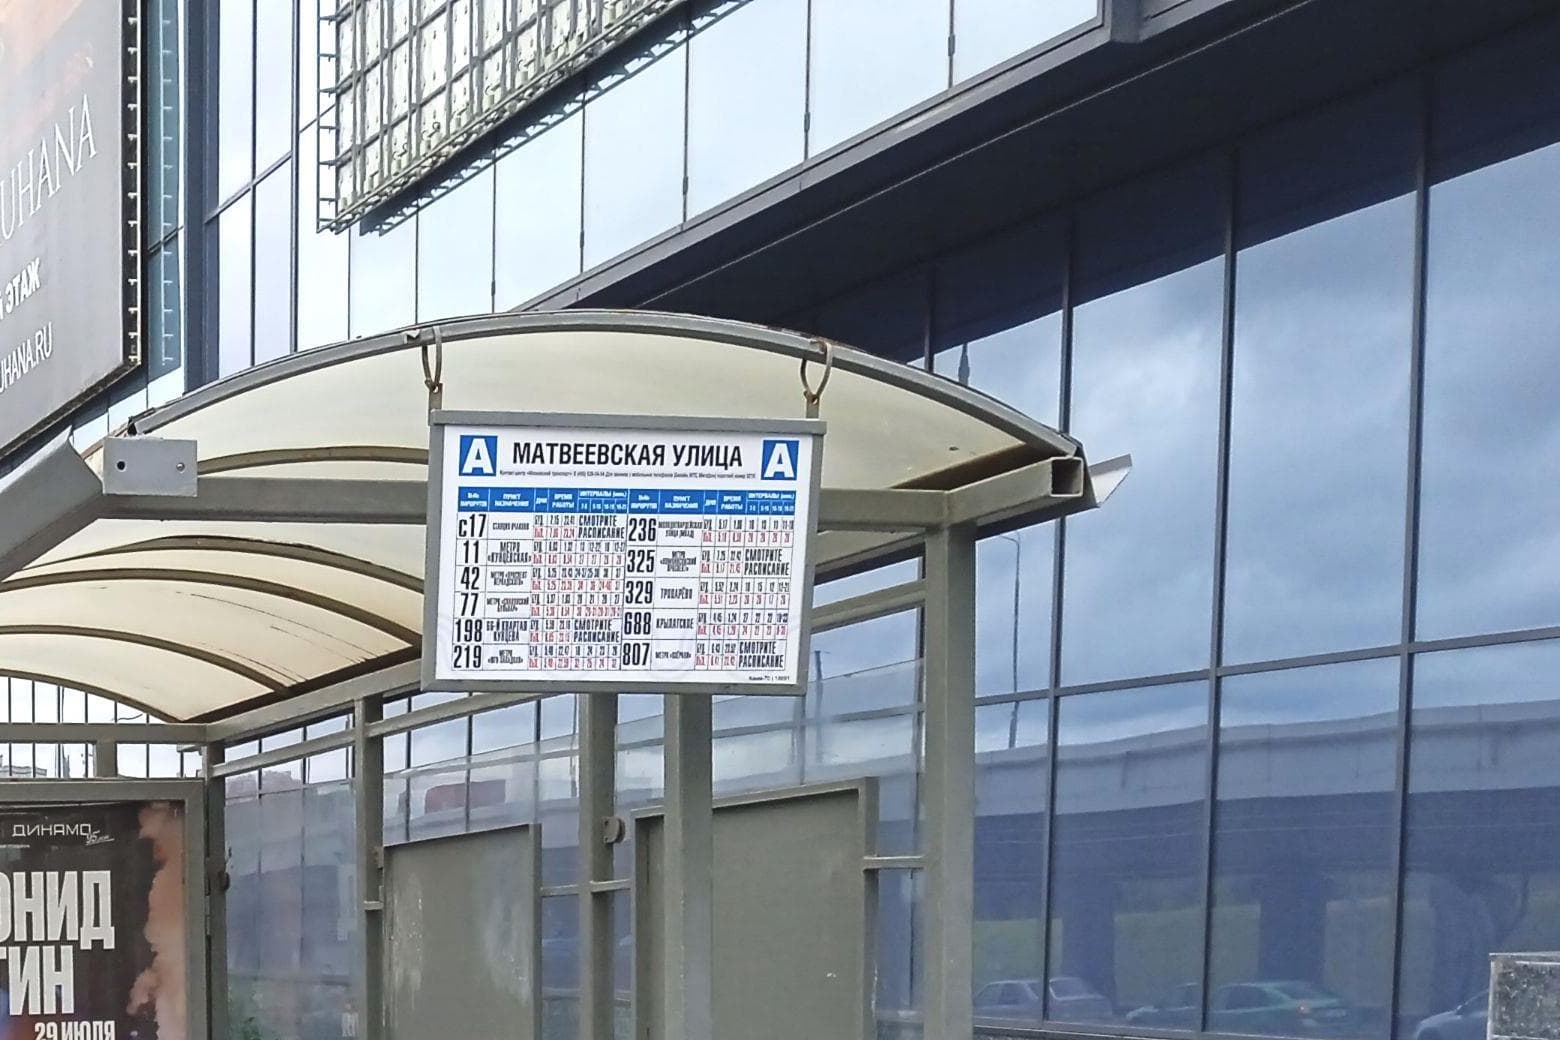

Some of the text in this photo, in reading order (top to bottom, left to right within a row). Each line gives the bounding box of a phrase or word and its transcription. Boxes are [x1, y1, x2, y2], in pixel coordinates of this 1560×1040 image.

[5, 257, 40, 316] ЭТАЖ
[462, 438, 795, 478] А МАТВЕЕВСКАЯ УЛИЦА А
[458, 514, 487, 538] с17
[578, 515, 617, 526] СМОТРИТЕ
[628, 518, 657, 541] 236
[578, 527, 626, 538] РАСПИСАНИЕ
[463, 540, 480, 563] 11
[627, 550, 655, 573] 325
[745, 549, 783, 561] СМОТРИТЕ
[460, 567, 480, 590] 42
[744, 563, 790, 576] РАСПИСАНИЕ
[460, 593, 479, 616] 77
[625, 581, 653, 605] 329
[455, 619, 483, 643] 198
[574, 619, 612, 631] СМОТРИТЕ
[624, 612, 651, 635] 688
[573, 631, 620, 643] РАСПИСАНИЕ
[739, 642, 777, 654] СМОТРИТЕ
[453, 645, 482, 668] 219
[622, 643, 650, 666] 807
[738, 655, 784, 668] РАСПИСАНИЕ
[12, 824, 91, 837] ДИНАМО
